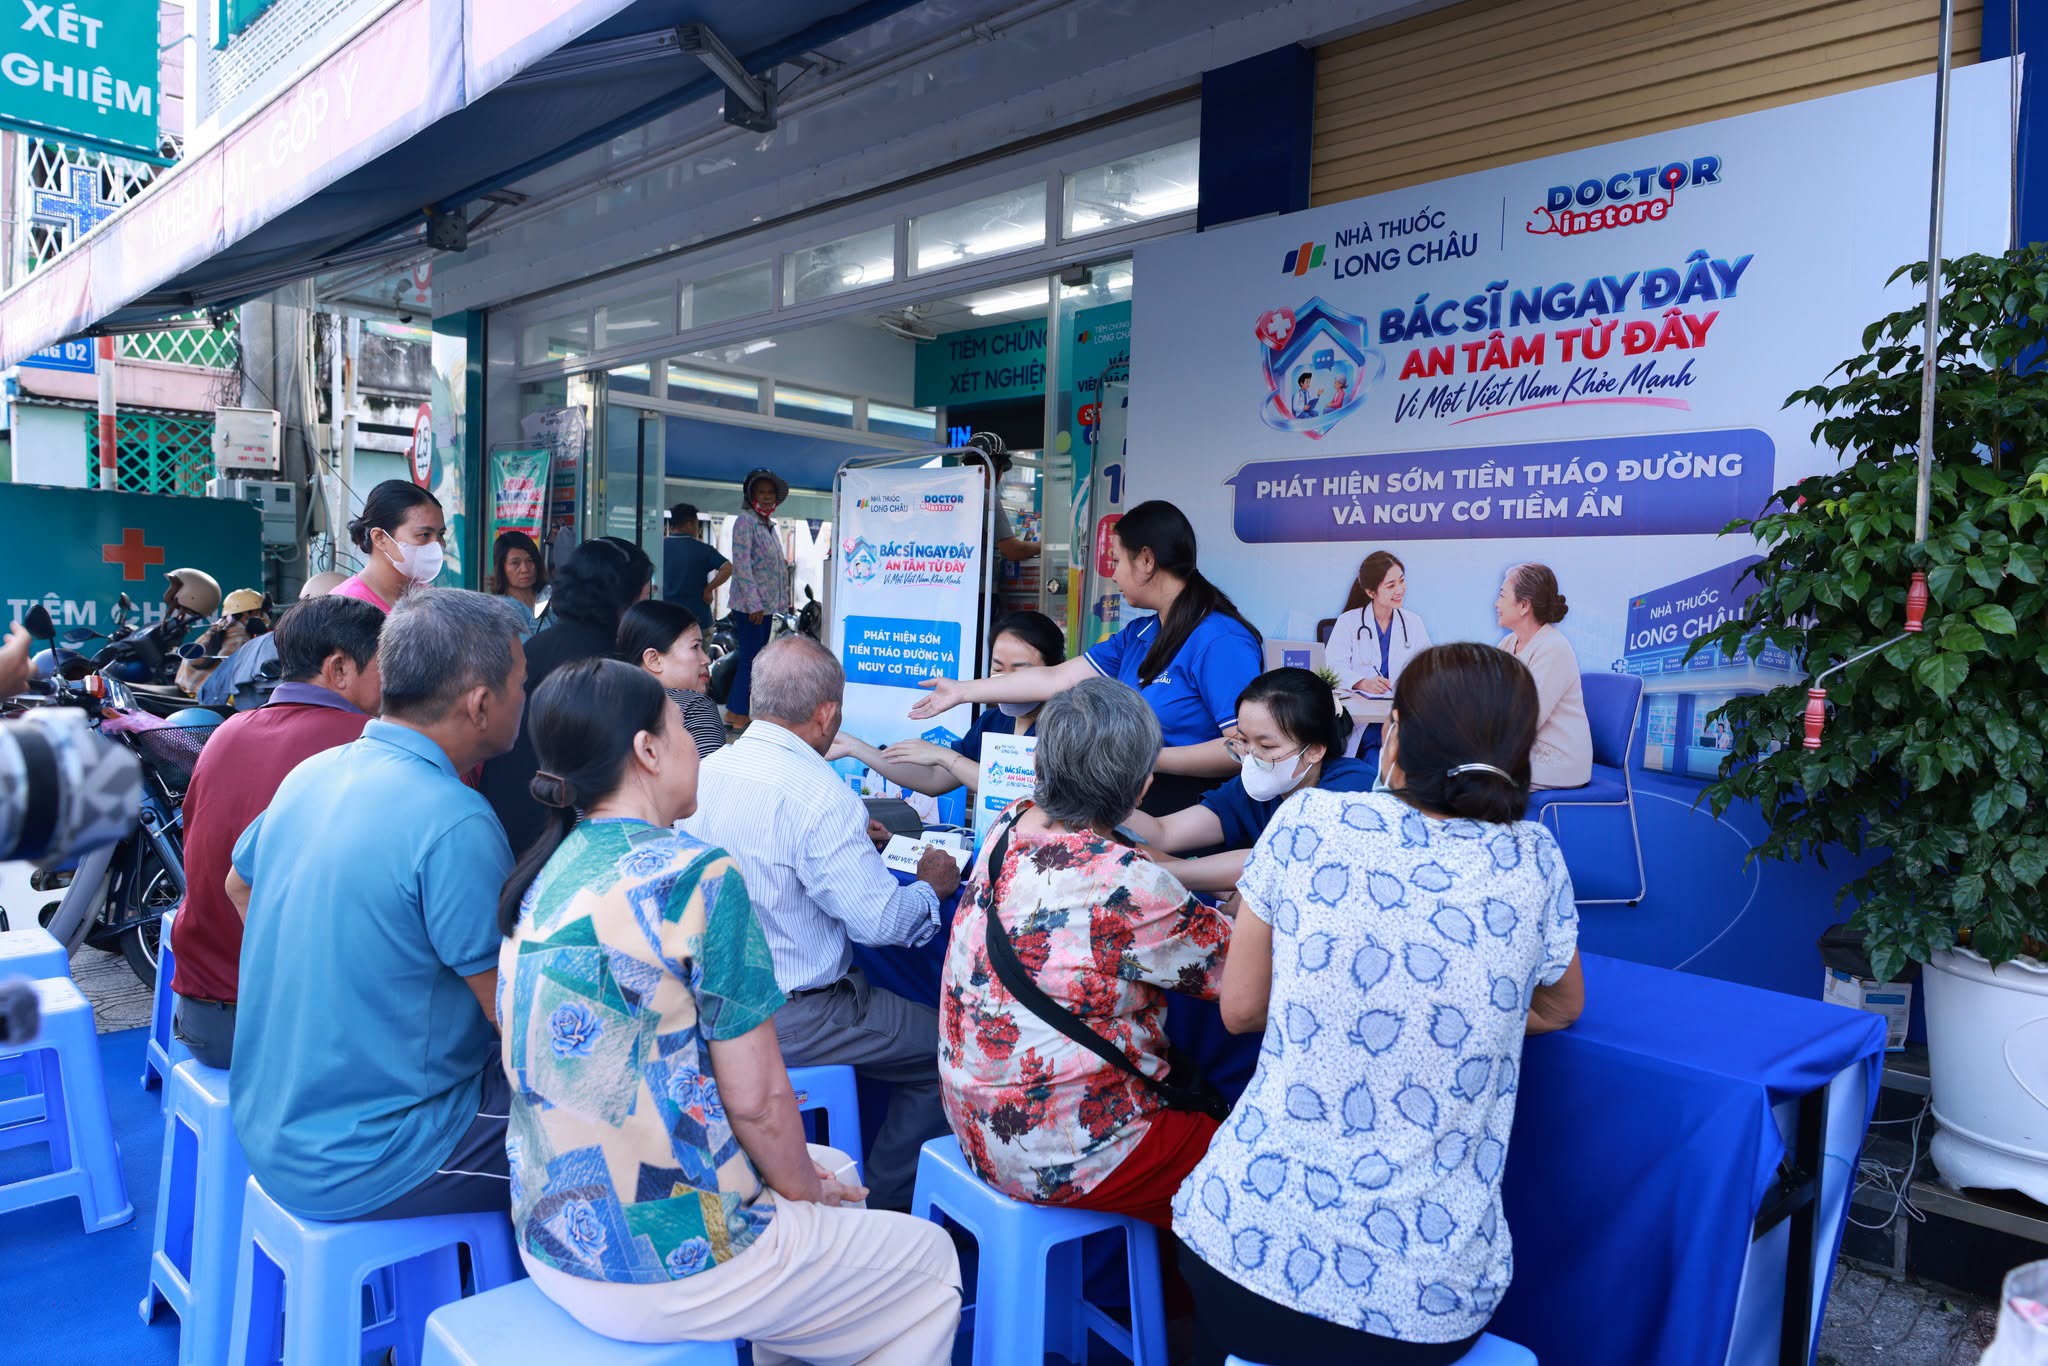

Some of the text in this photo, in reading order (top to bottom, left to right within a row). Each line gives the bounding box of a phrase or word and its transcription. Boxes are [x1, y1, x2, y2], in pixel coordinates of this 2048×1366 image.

[20, 0, 103, 49] XÉT
[270, 83, 328, 169] GÓP
[1547, 154, 1721, 213] DOCTOR
[1335, 205, 1446, 249] NHÀ THUỐC
[1562, 200, 1666, 235] instore
[1334, 230, 1478, 280] LONG CHÂU
[1379, 248, 1755, 345] BÁC SĨ NGAY ĐÂY
[33, 342, 87, 362] NG 02
[948, 333, 986, 360] TIÊM
[1398, 306, 1721, 381] AN TÂM TỪ ĐÂY
[949, 367, 981, 395] XÉT
[1394, 357, 1697, 424] Vì Một Việt Nam Khỏe Mạnh
[947, 425, 972, 448] IN
[1256, 450, 1743, 500] PHÁT HIỆN SỚM TIỀN THÁO ĐƯỜNG
[870, 504, 888, 513] LONG
[924, 494, 964, 503] DOCTOR
[1332, 487, 1624, 525] VÀ NGUY CƠ TIỀM ẨN
[880, 541, 975, 559] BÁC SĨ NGAY ĐÂY
[885, 558, 966, 573] AN TÂM TỪ ĐÂY
[7, 592, 97, 626] TÊM
[1650, 588, 1720, 620] NHÀ THUỐC
[864, 629, 941, 645] PHÁT HIỆN SỚM
[1629, 623, 1679, 651] LONG
[857, 661, 885, 673] NGUY
[887, 663, 903, 674] CƠ
[872, 645, 900, 658] THÁO
[903, 647, 939, 660] ĐƯỜNG
[941, 650, 955, 663] VÀ
